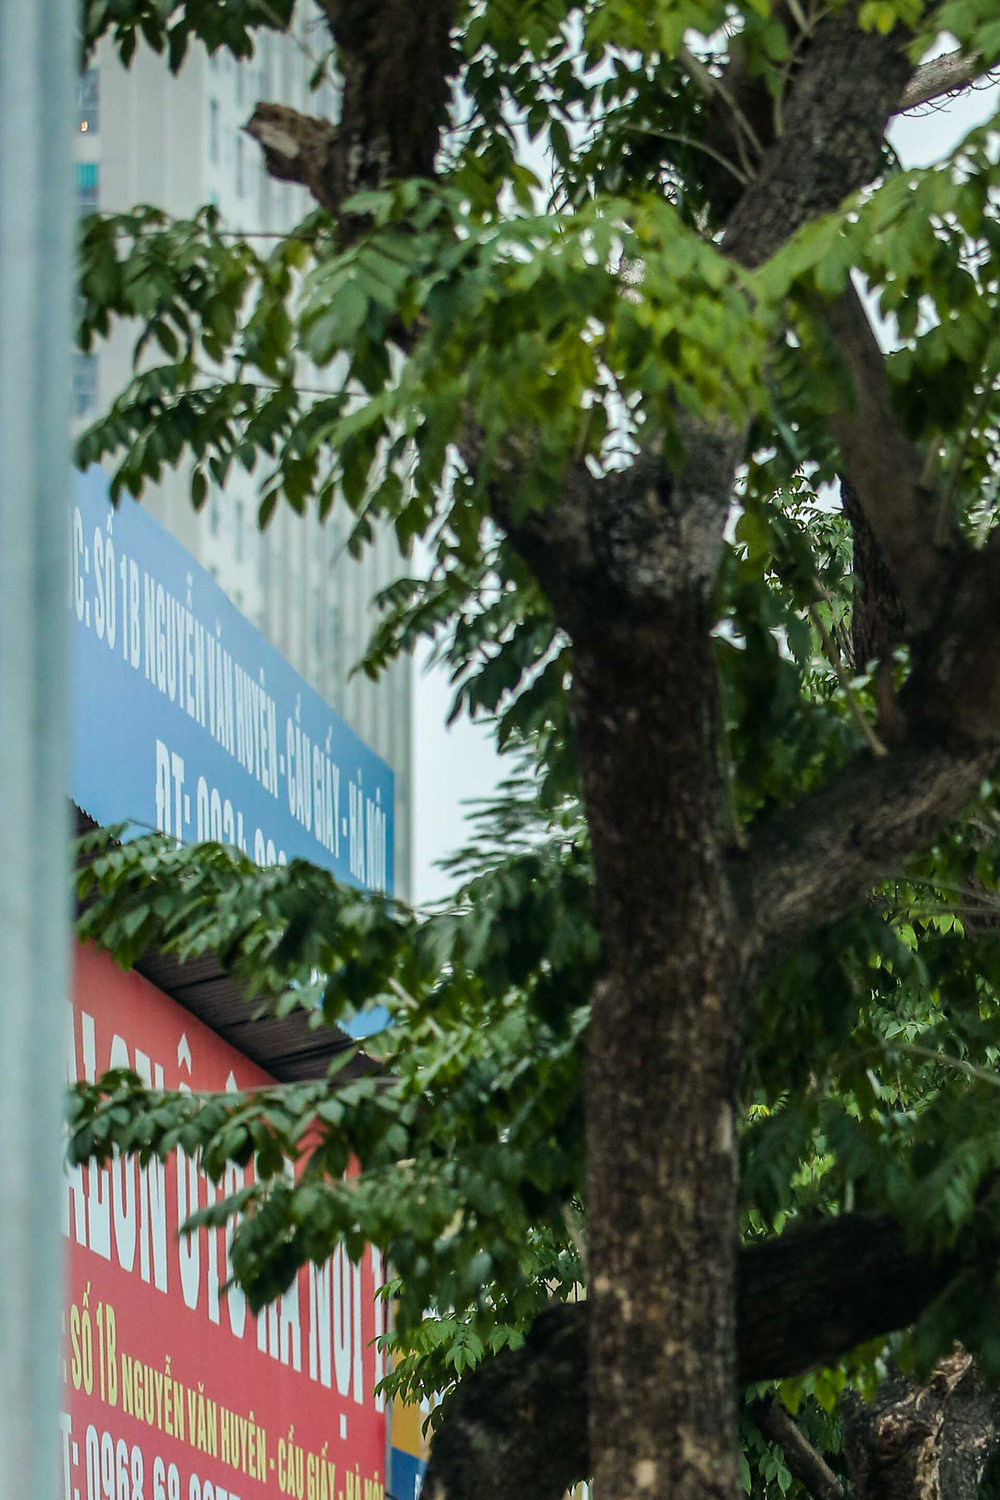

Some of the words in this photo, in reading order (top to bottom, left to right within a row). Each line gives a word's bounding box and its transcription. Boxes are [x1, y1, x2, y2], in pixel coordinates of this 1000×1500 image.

[72, 507, 90, 628] C:
[94, 507, 116, 649] SỐ
[120, 554, 140, 669] 1B
[60, 998, 168, 1294] ALON
[70, 1281, 93, 1395] SỐ
[96, 1302, 117, 1406] 1B
[121, 1354, 184, 1441] NGUYỄN
[187, 1381, 217, 1459] VĂN
[220, 1410, 267, 1483] HUYÊN
